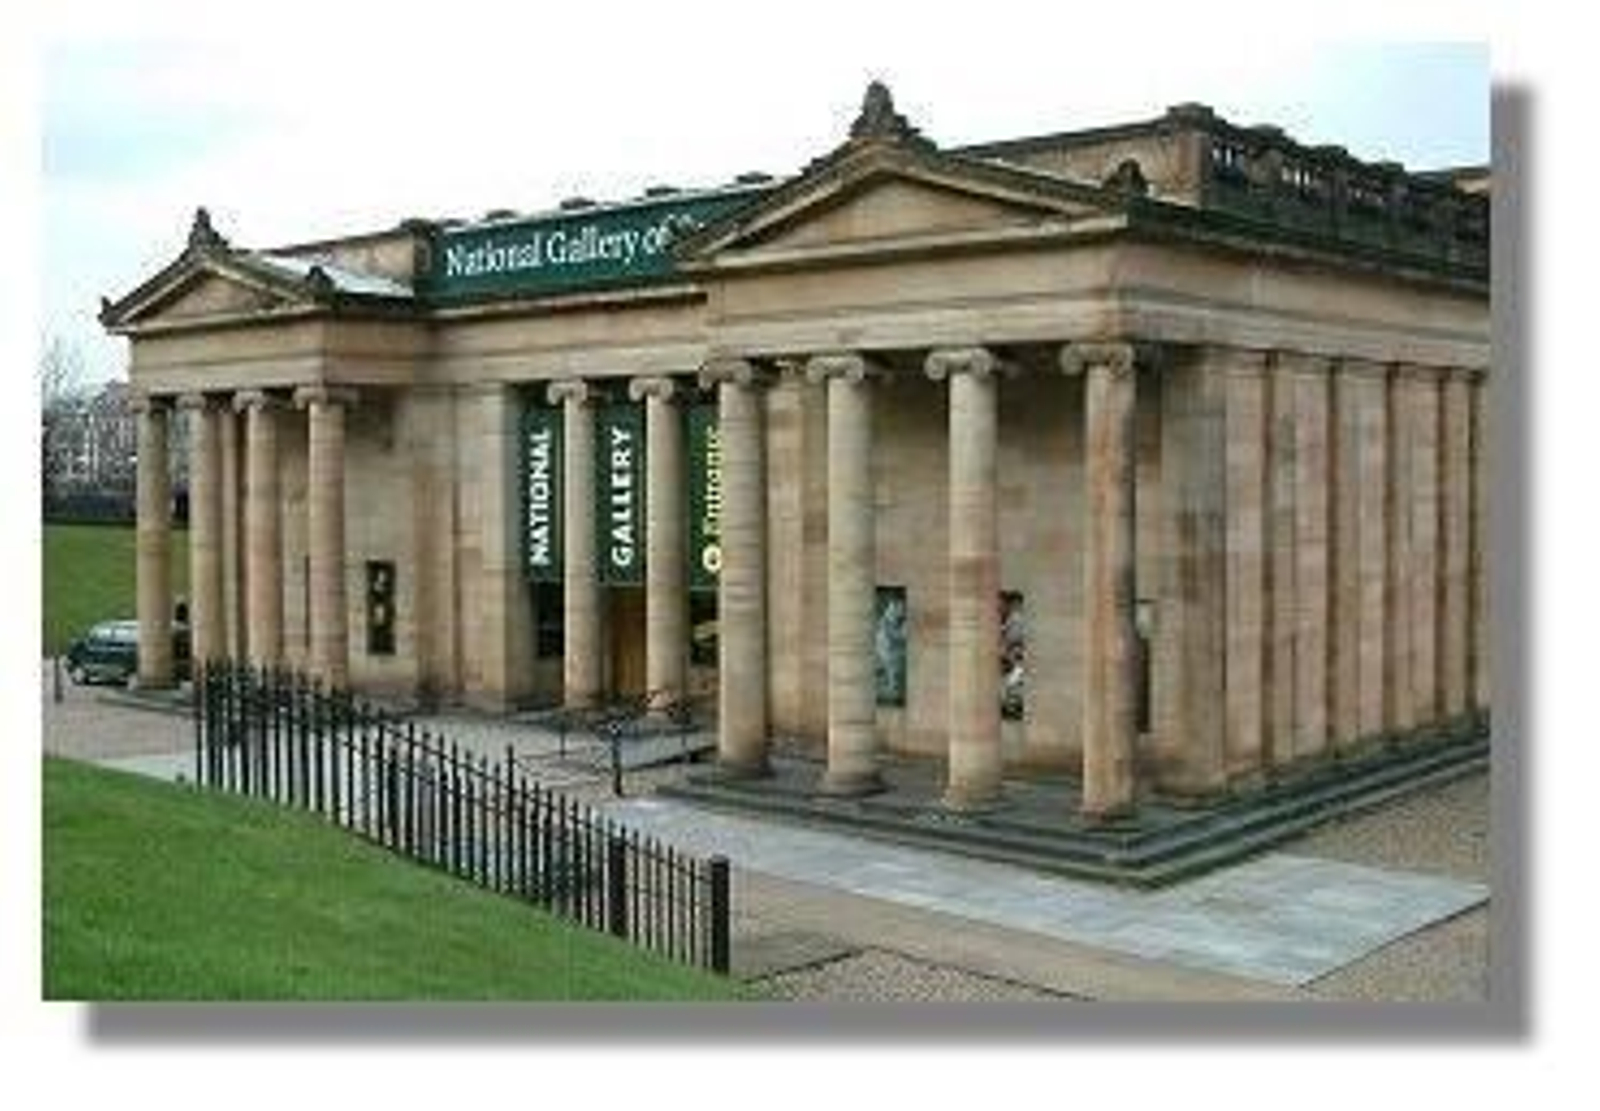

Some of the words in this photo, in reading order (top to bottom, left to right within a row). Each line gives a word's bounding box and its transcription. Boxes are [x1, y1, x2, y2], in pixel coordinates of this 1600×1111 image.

[446, 236, 543, 277] National
[546, 225, 640, 264] Gallery
[530, 428, 550, 566] NATIONAL
[611, 427, 633, 567] GALLERY
